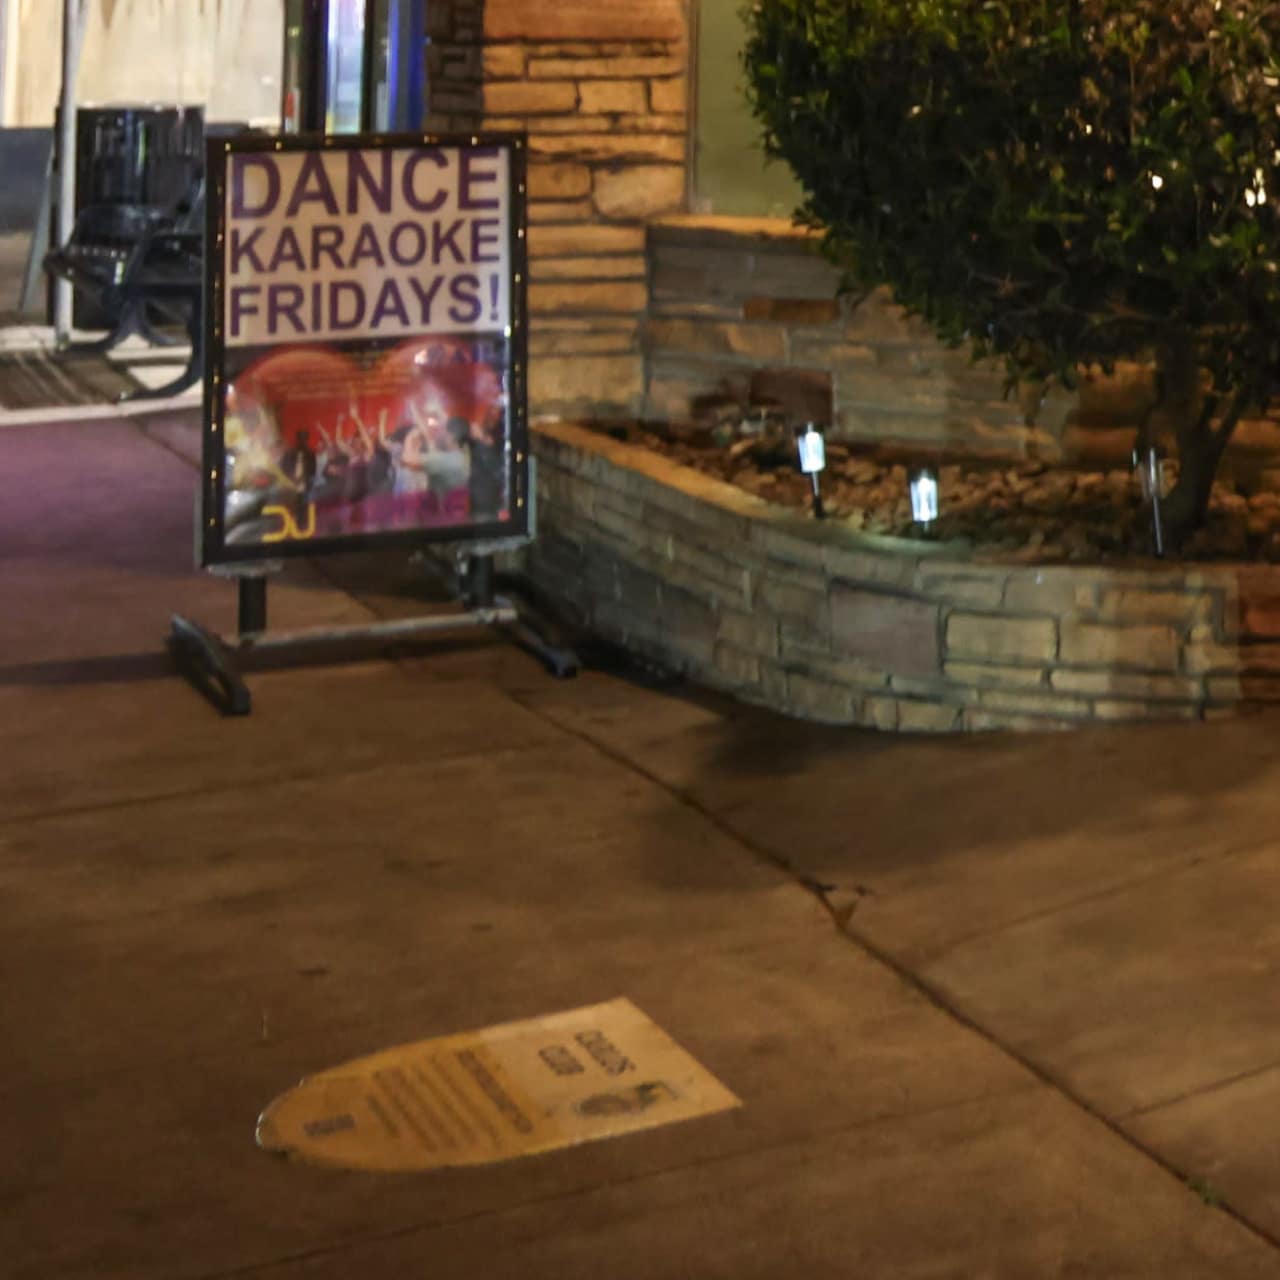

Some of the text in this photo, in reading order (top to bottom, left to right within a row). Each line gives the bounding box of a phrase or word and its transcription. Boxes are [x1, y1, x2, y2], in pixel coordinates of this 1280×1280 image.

[231, 146, 499, 219] DANCE
[231, 220, 499, 274] KARAOKE
[230, 274, 499, 337] FRIDAYS!
